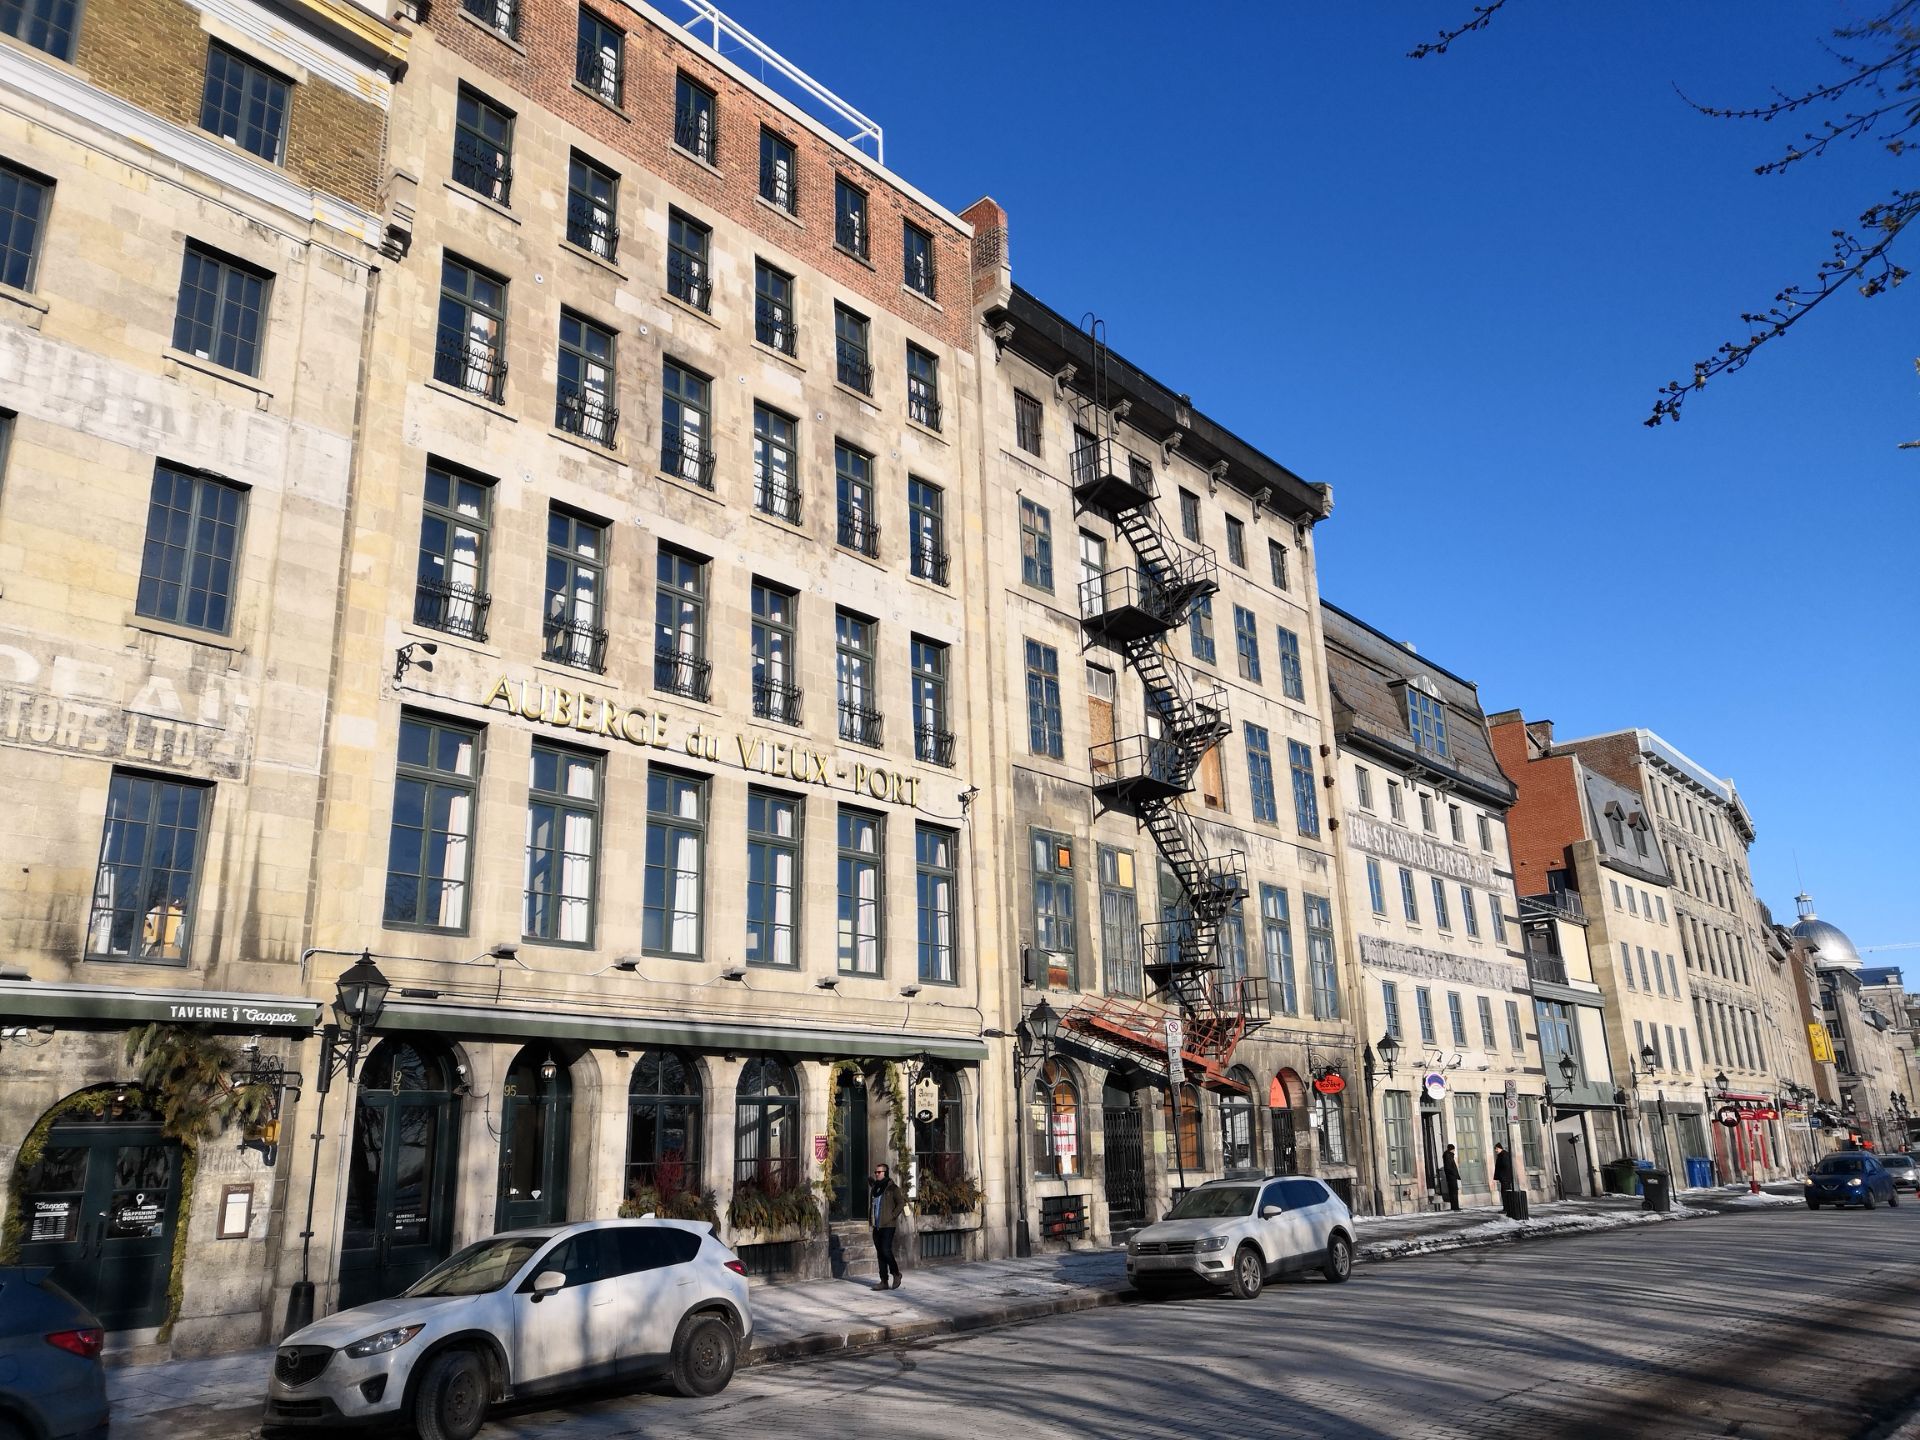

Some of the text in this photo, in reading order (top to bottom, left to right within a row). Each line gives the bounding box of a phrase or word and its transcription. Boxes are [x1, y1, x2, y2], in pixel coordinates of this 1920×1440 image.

[483, 674, 671, 749] AUBERGE
[685, 722, 720, 763] du
[1372, 825, 1436, 870] STANDARD
[170, 1005, 298, 1025] TAVERNE Gaspar
[503, 1084, 517, 1097] 95
[35, 1202, 69, 1212] Gaspar
